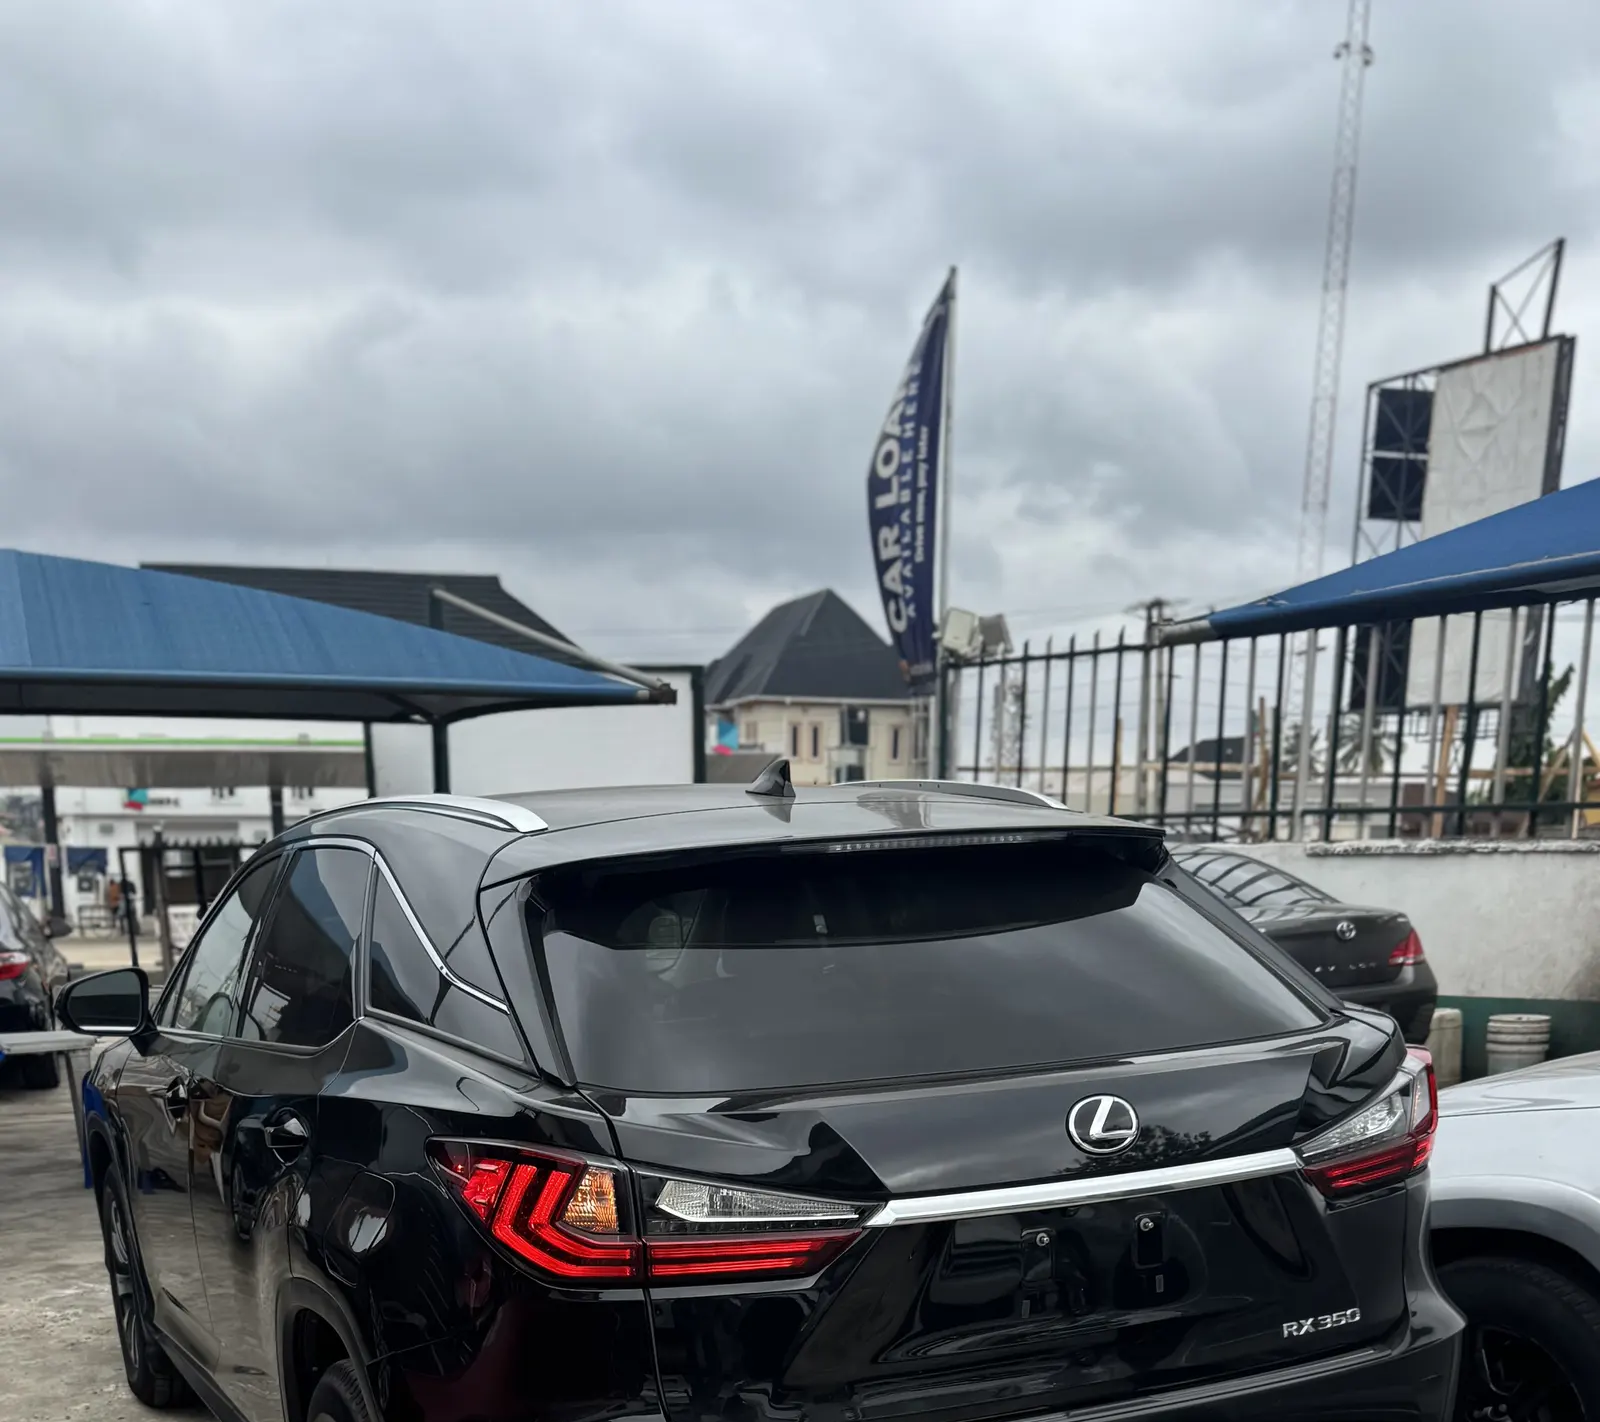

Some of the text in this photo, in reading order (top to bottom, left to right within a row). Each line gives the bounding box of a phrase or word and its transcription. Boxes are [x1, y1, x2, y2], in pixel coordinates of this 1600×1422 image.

[877, 524, 908, 633] CAR
[900, 448, 917, 618] AVAILABLE
[1317, 1307, 1361, 1330] 350
